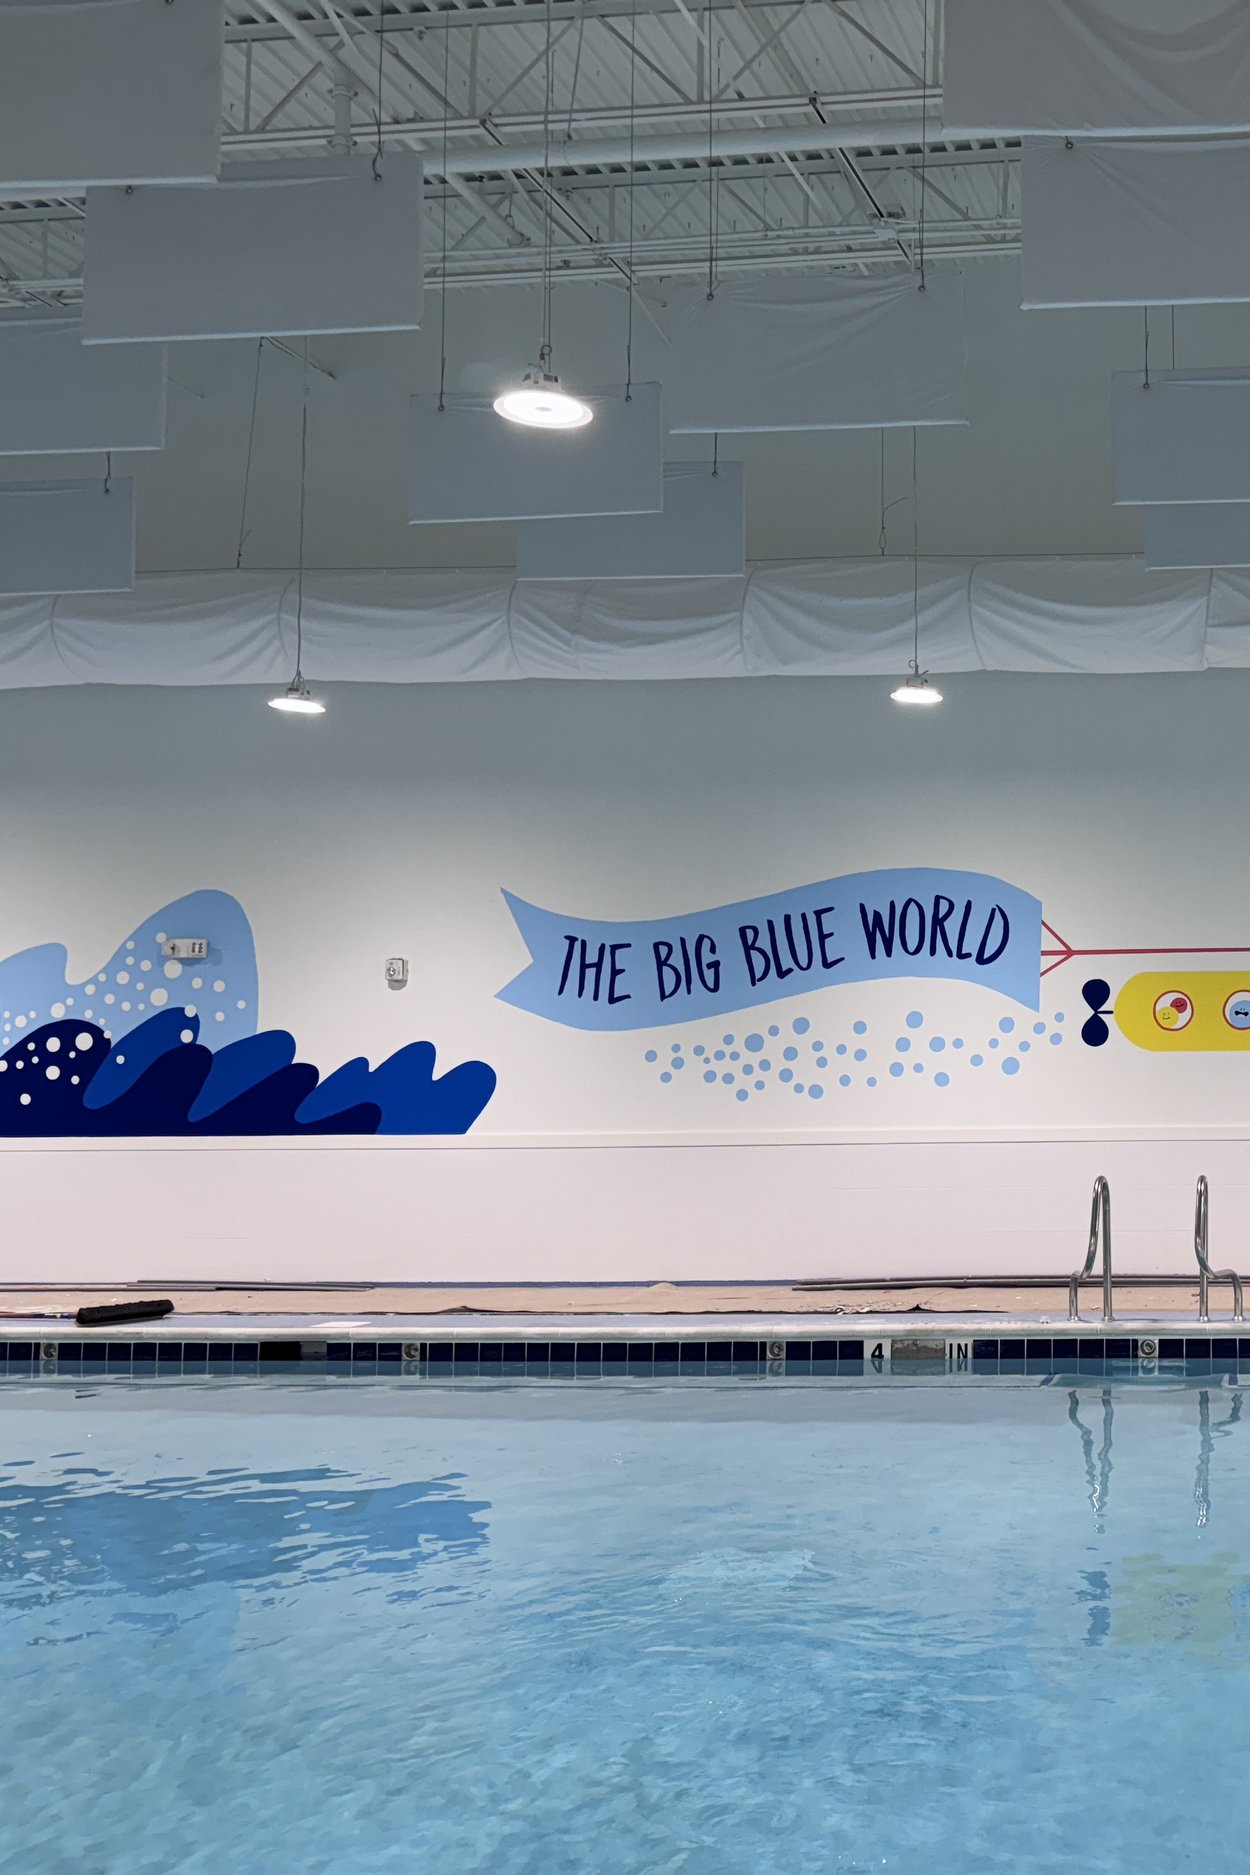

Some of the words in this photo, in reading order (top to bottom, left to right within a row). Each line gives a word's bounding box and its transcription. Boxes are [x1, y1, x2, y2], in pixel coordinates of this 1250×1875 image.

[557, 934, 632, 1005] THE
[652, 933, 721, 1003] BIG
[738, 906, 846, 987] BLUE
[858, 894, 1010, 966] WORLD
[870, 1343, 884, 1359] 4
[949, 1343, 968, 1360] IN
